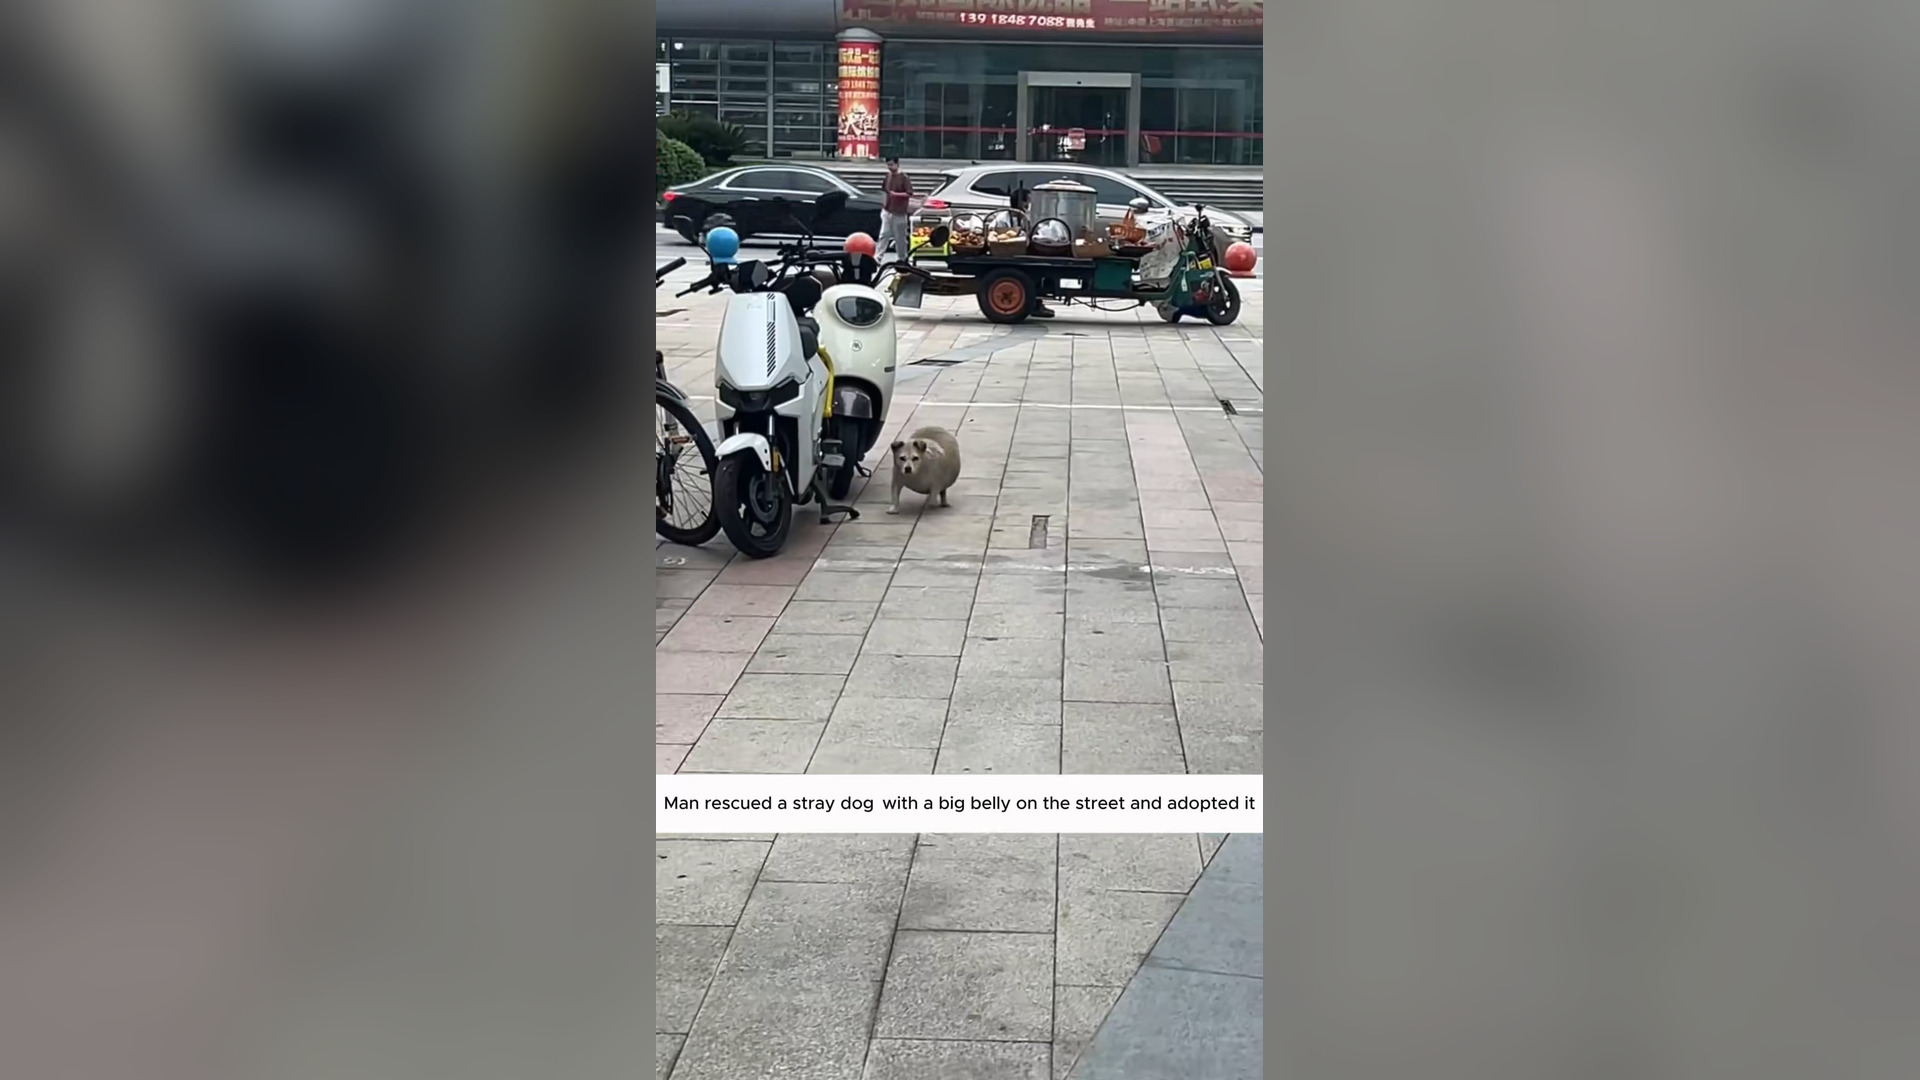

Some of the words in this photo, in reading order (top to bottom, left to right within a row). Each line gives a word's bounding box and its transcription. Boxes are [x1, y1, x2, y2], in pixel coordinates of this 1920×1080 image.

[960, 12, 987, 24] 139
[991, 14, 1026, 26] 1848
[1028, 15, 1065, 27] 7088
